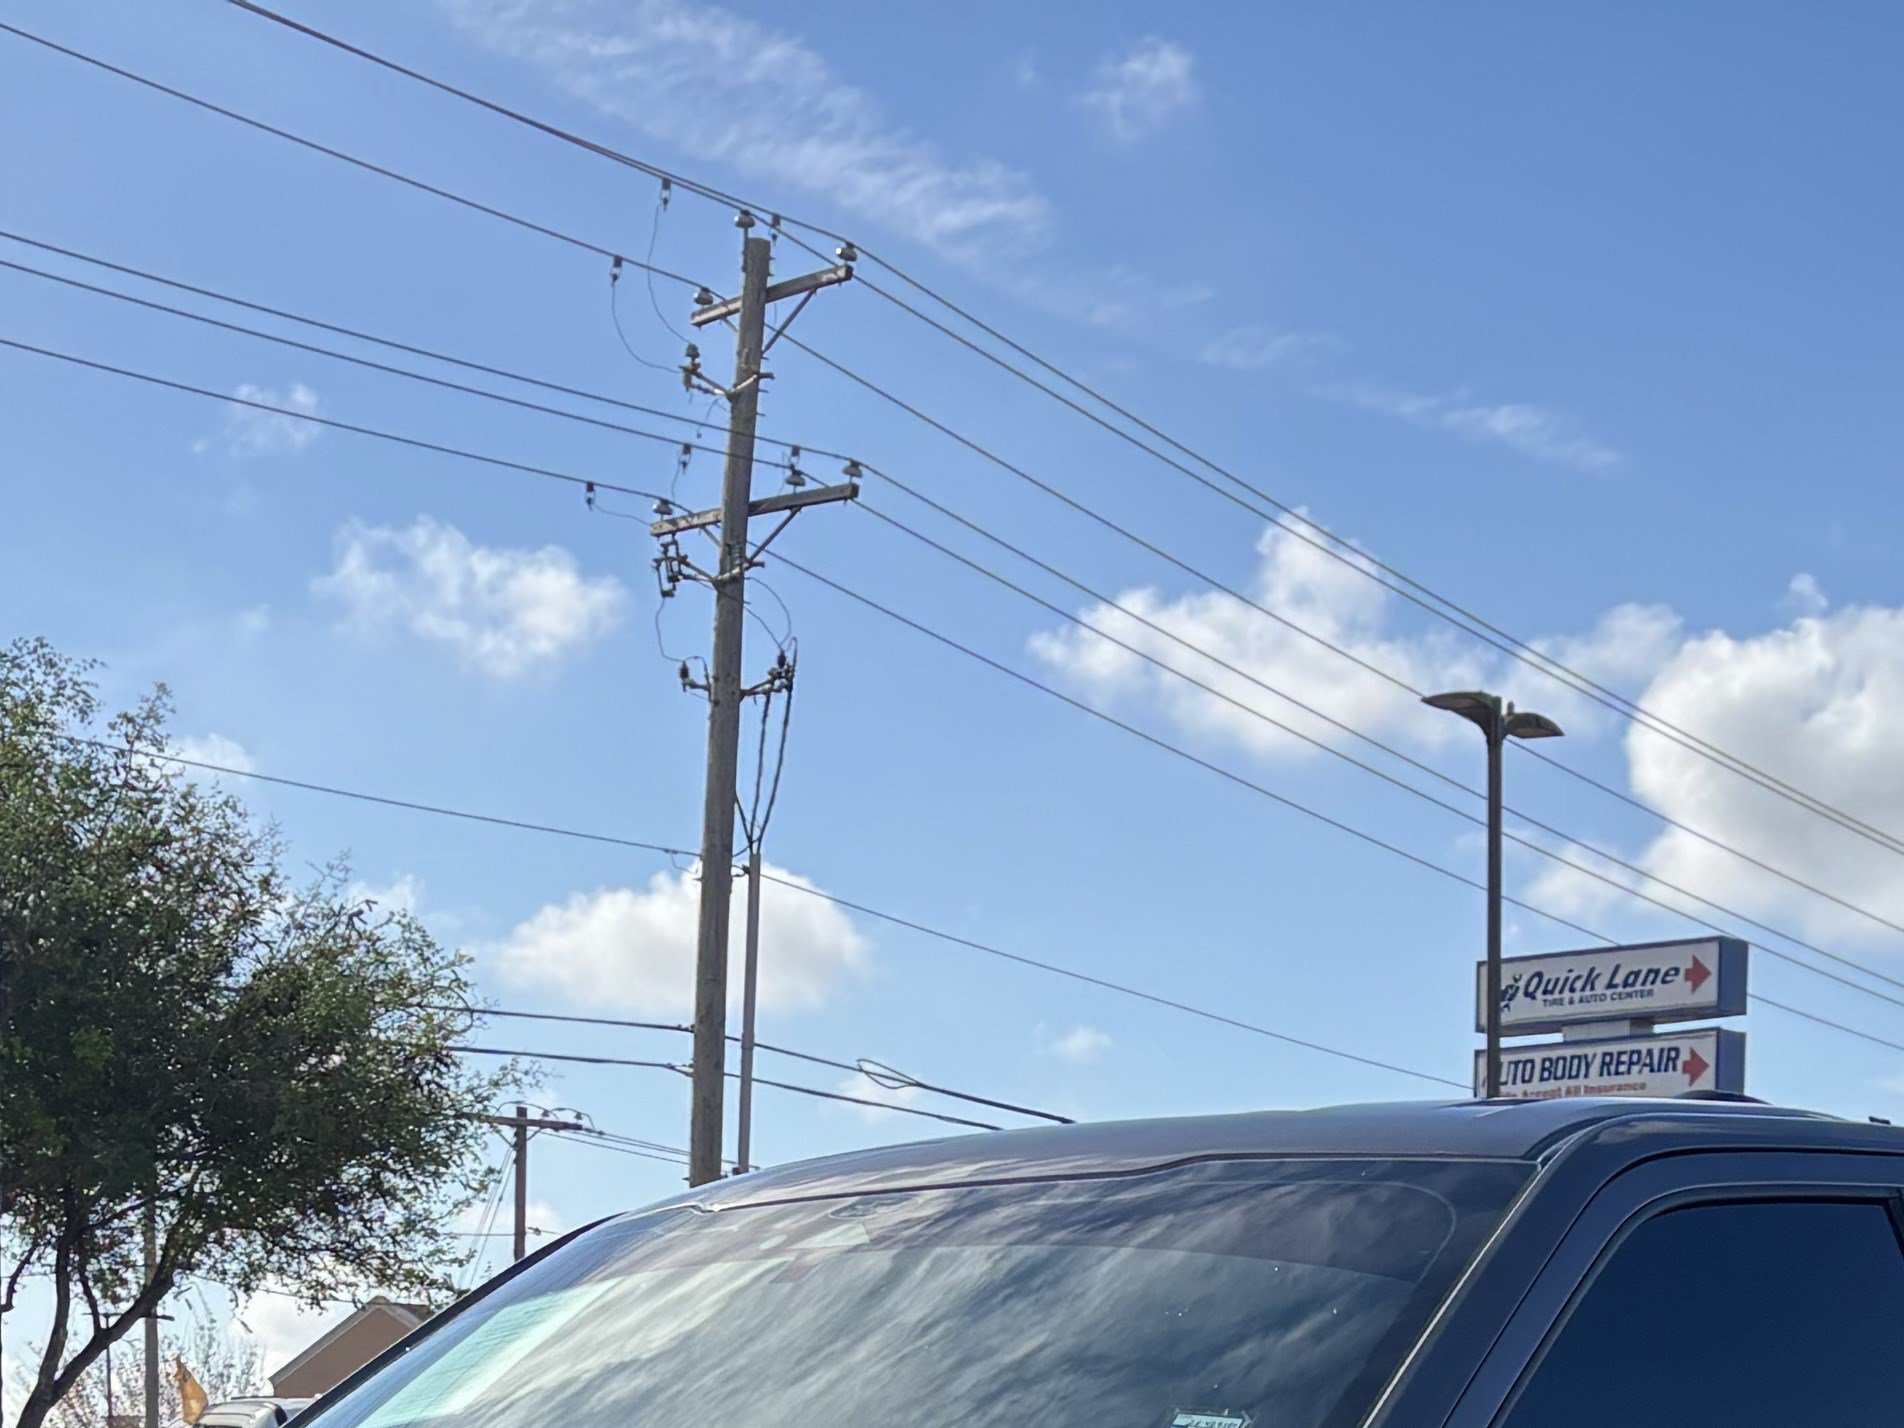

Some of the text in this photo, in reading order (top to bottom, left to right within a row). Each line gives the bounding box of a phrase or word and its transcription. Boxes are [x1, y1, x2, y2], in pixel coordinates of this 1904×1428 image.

[1523, 963, 1681, 1000] Quick Lane
[1543, 995, 1565, 1008] TIRE
[1578, 993, 1607, 1005] AUTO
[1609, 988, 1654, 1001] CENTER
[1483, 1046, 1681, 1087] UTO BODY REPAIR
